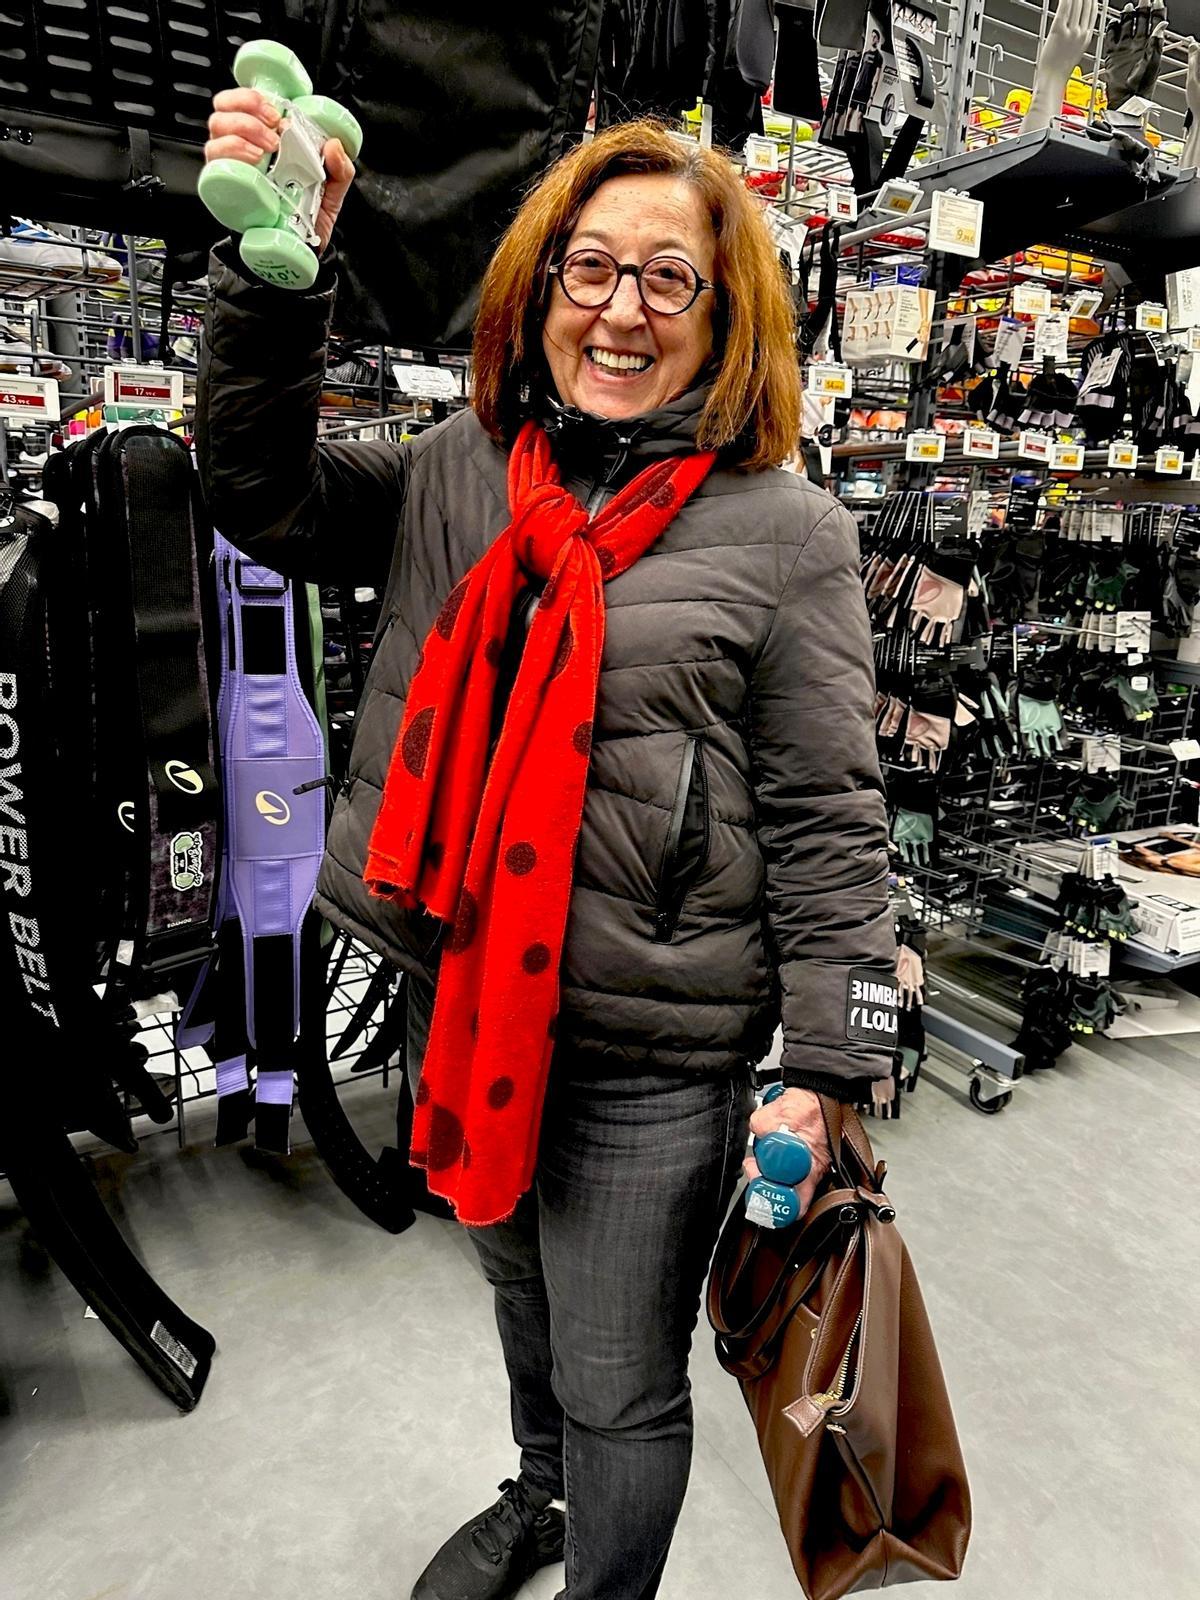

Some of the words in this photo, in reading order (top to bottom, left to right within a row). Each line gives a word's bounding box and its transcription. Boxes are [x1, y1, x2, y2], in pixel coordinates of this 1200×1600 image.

[8, 911, 60, 1028] BELT
[771, 1192, 786, 1202] LBS
[773, 1203, 790, 1215] KG
